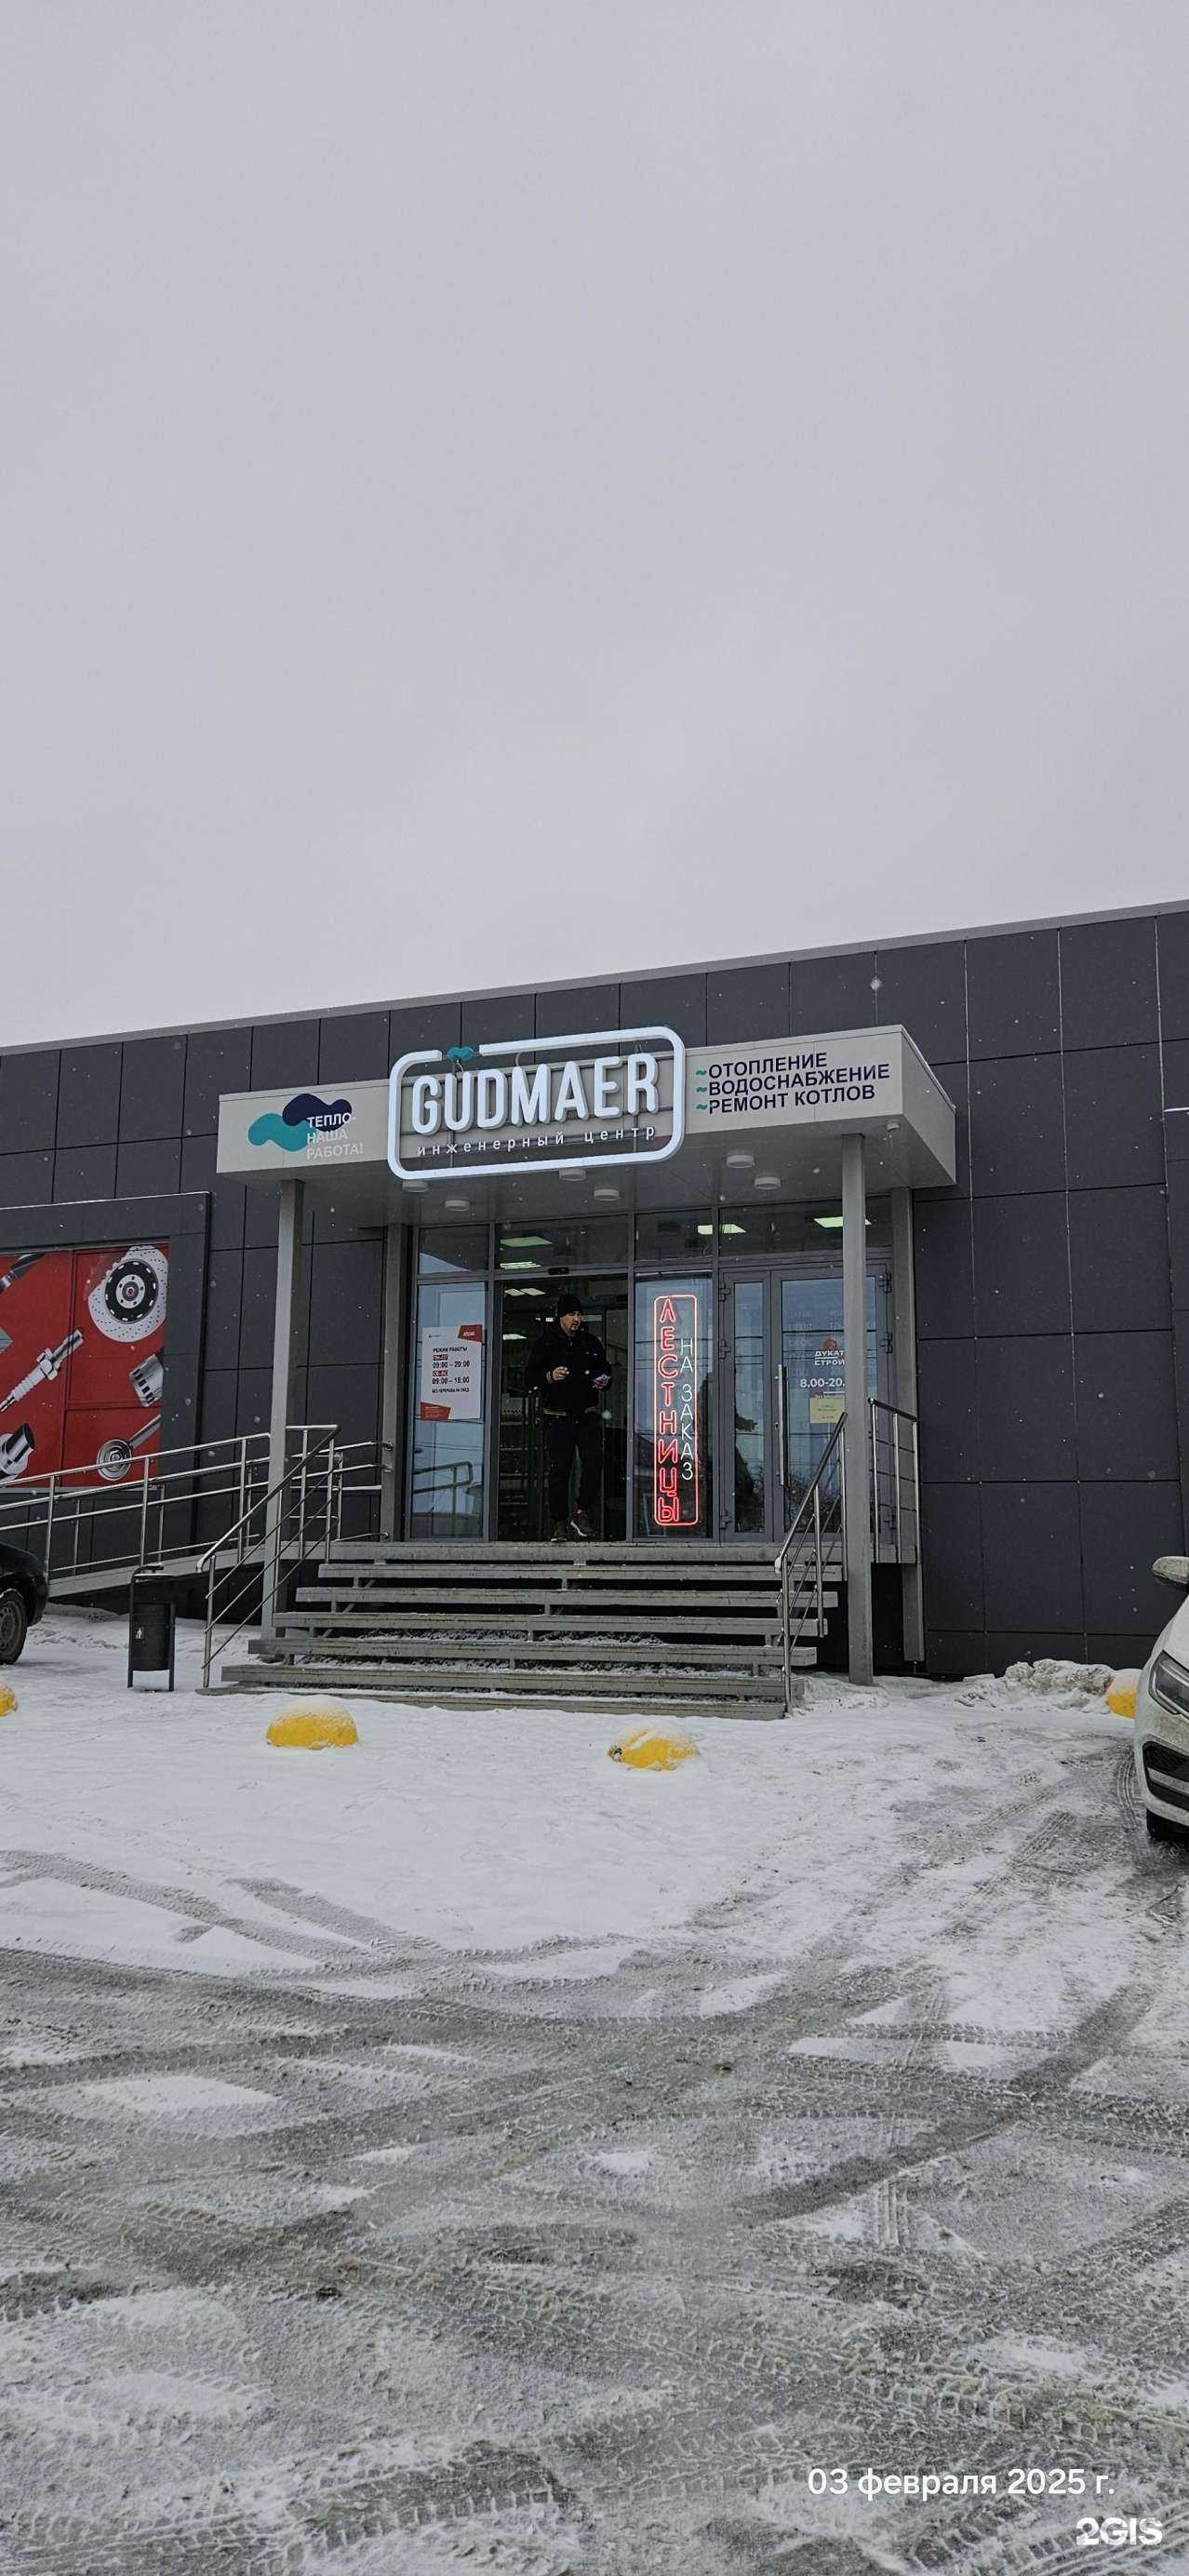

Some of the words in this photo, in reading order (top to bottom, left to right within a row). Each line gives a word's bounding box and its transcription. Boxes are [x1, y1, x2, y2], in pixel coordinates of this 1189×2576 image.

[709, 1053, 827, 1079] ОТОПЛЕНИЕ
[709, 1064, 890, 1096] ВОДОСНАБЖЕНИЕ
[411, 1053, 659, 1136] GUDMAER
[709, 1093, 788, 1114] РЕМОНТ
[795, 1084, 875, 1107] КОТЛОВ
[306, 1128, 349, 1145] НАША
[306, 1142, 364, 1161] РАБОТА!
[418, 1131, 564, 1157] инженерный
[584, 1126, 655, 1144] центр
[680, 1338, 694, 1375] НА
[800, 1378, 846, 1388] 8.00-20.
[657, 1298, 679, 1523] ЛЕСТНИЦЫ
[680, 1383, 694, 1481] ЗАКАЗ
